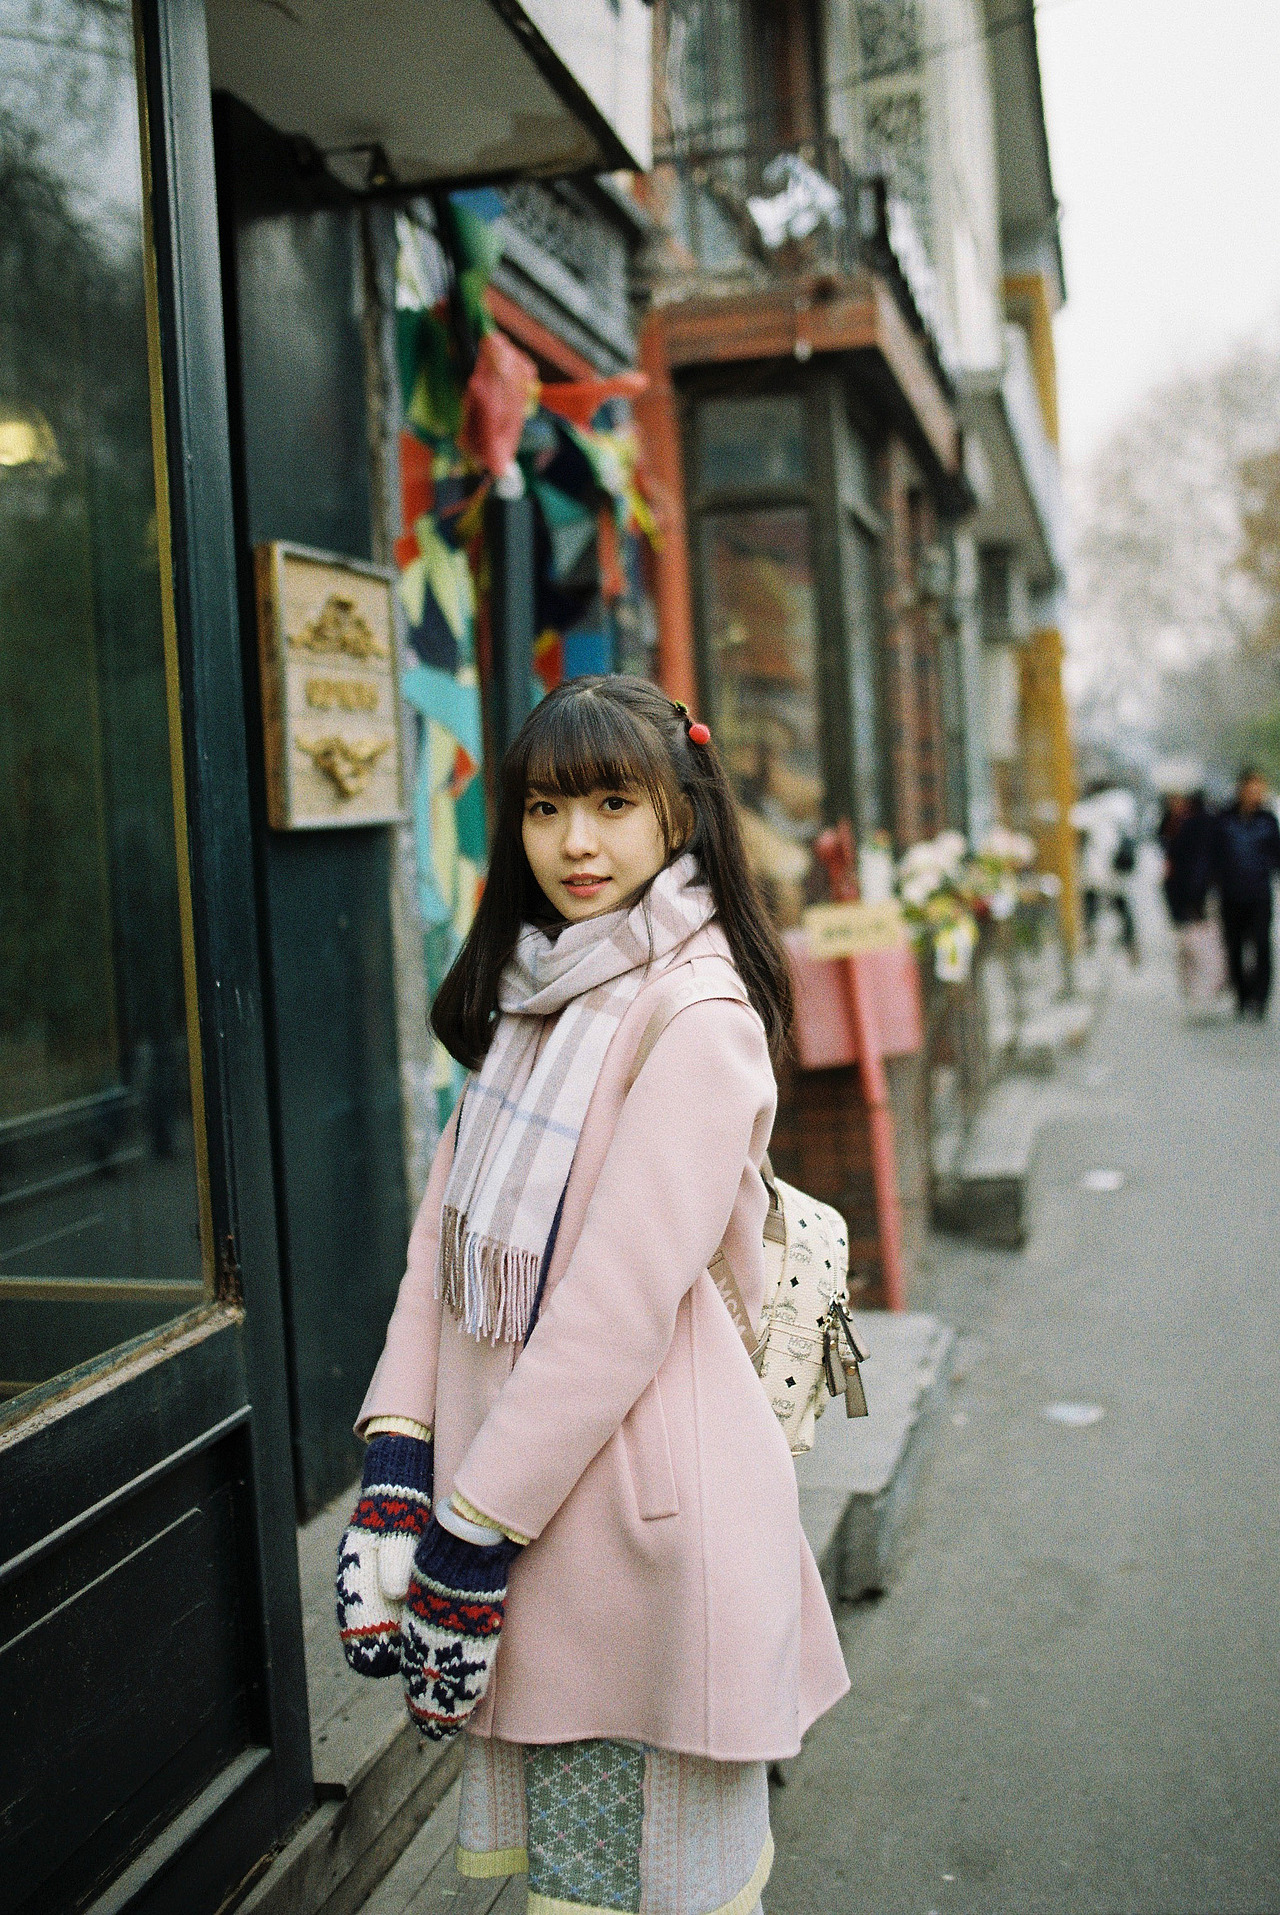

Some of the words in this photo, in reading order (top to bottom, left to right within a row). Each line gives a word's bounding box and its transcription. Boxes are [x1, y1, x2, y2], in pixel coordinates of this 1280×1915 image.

[716, 1277, 747, 1335] MCM
[788, 1336, 813, 1349] MCM
[772, 1396, 795, 1410] MCM
